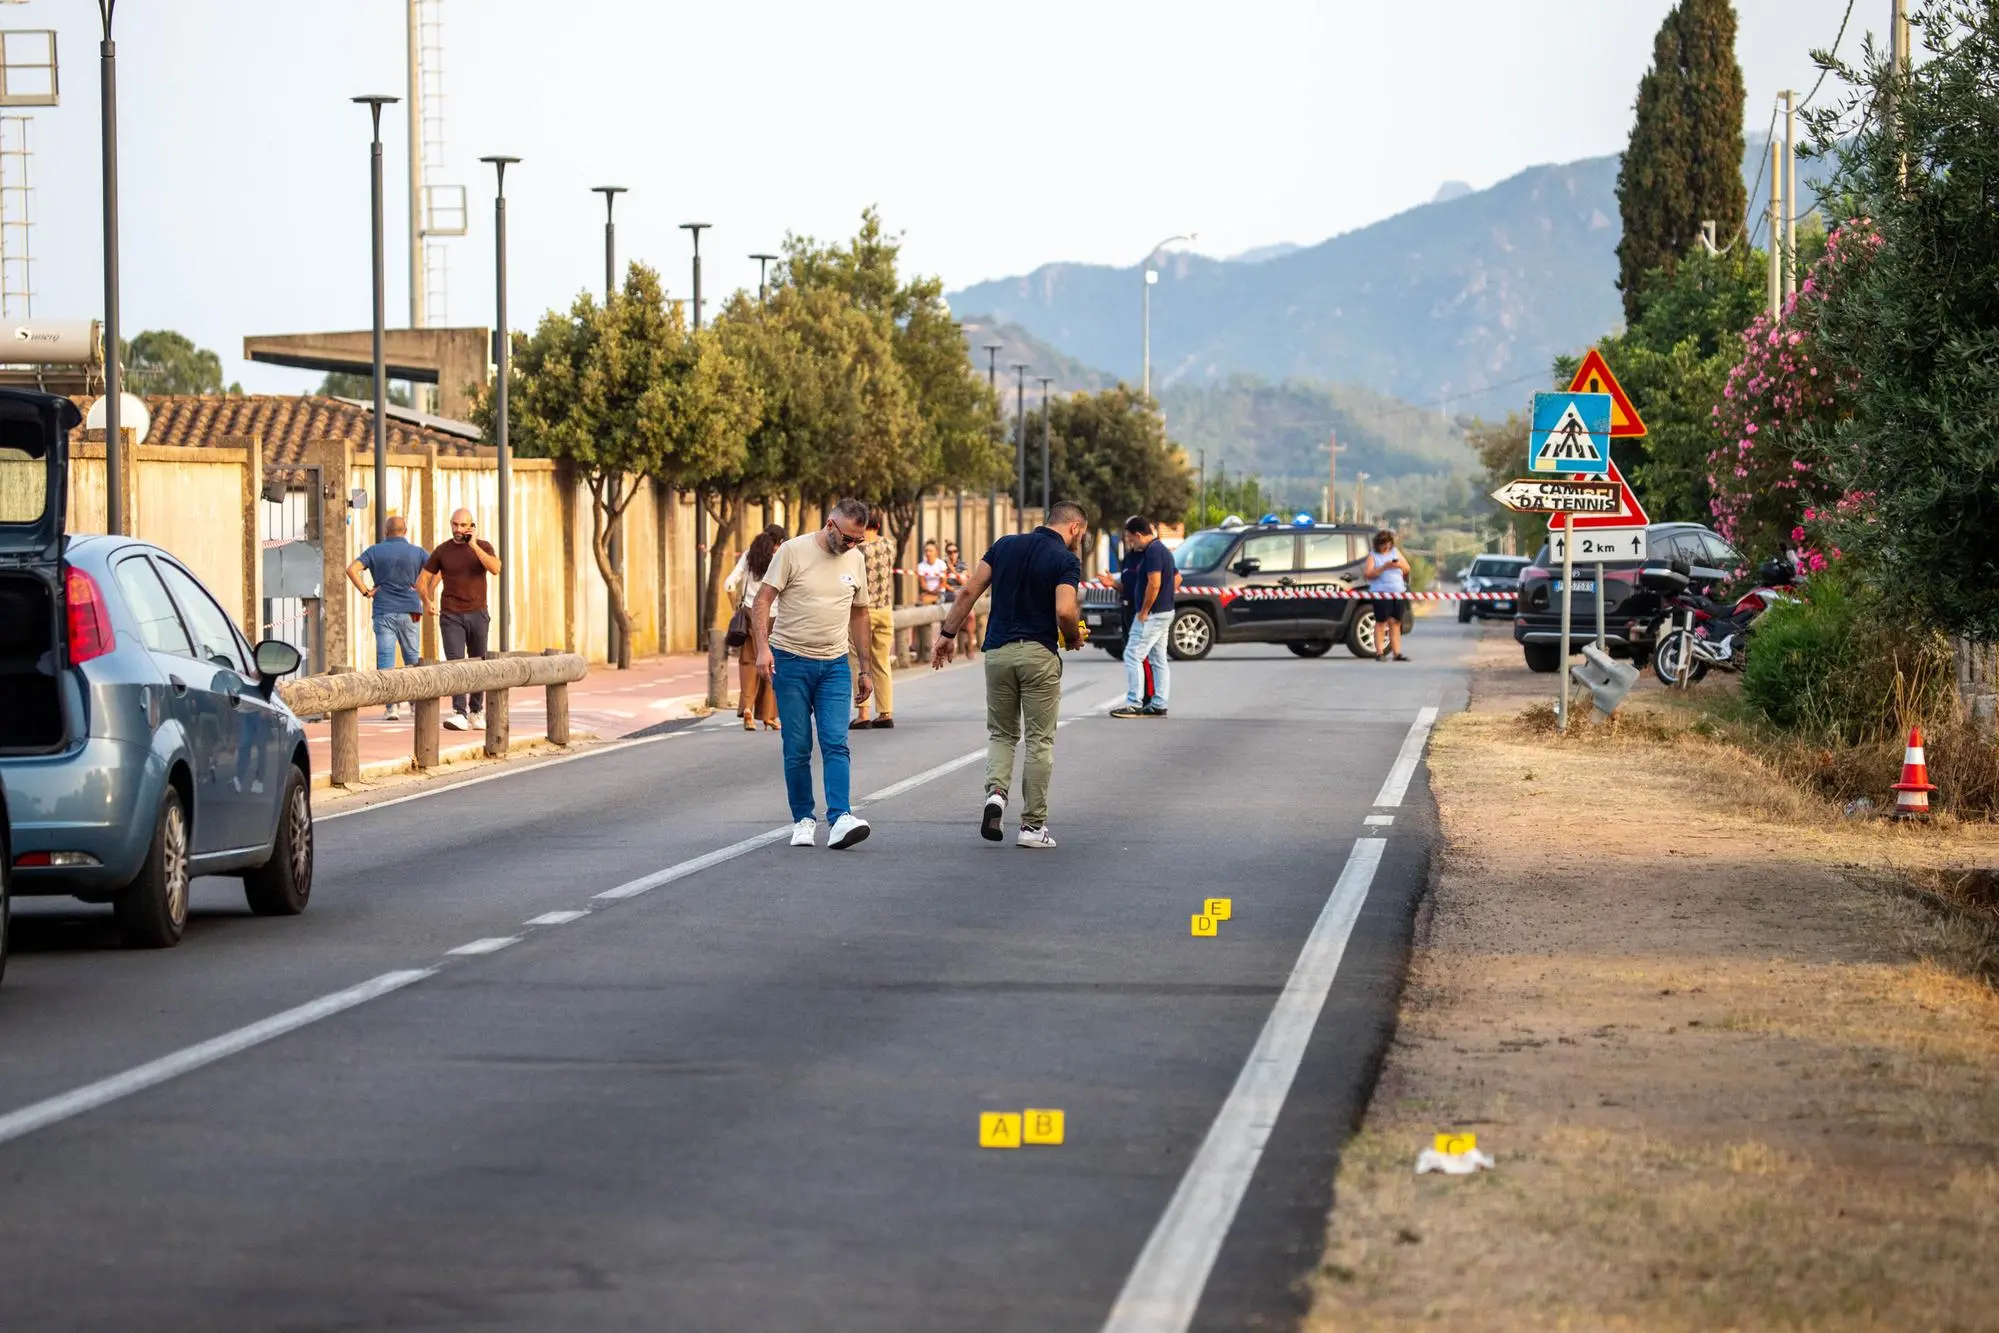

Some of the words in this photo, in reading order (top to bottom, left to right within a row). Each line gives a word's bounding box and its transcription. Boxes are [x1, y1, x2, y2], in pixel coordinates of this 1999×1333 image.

[1520, 496, 1545, 509] DA
[1551, 498, 1615, 511] TENNIS
[1583, 540, 1593, 553] 2
[1597, 543, 1615, 553] km
[1211, 901, 1222, 915] E
[1199, 916, 1211, 931] D
[991, 1118, 1010, 1138] A
[1035, 1114, 1053, 1136] B
[1446, 1138, 1465, 1156] C
